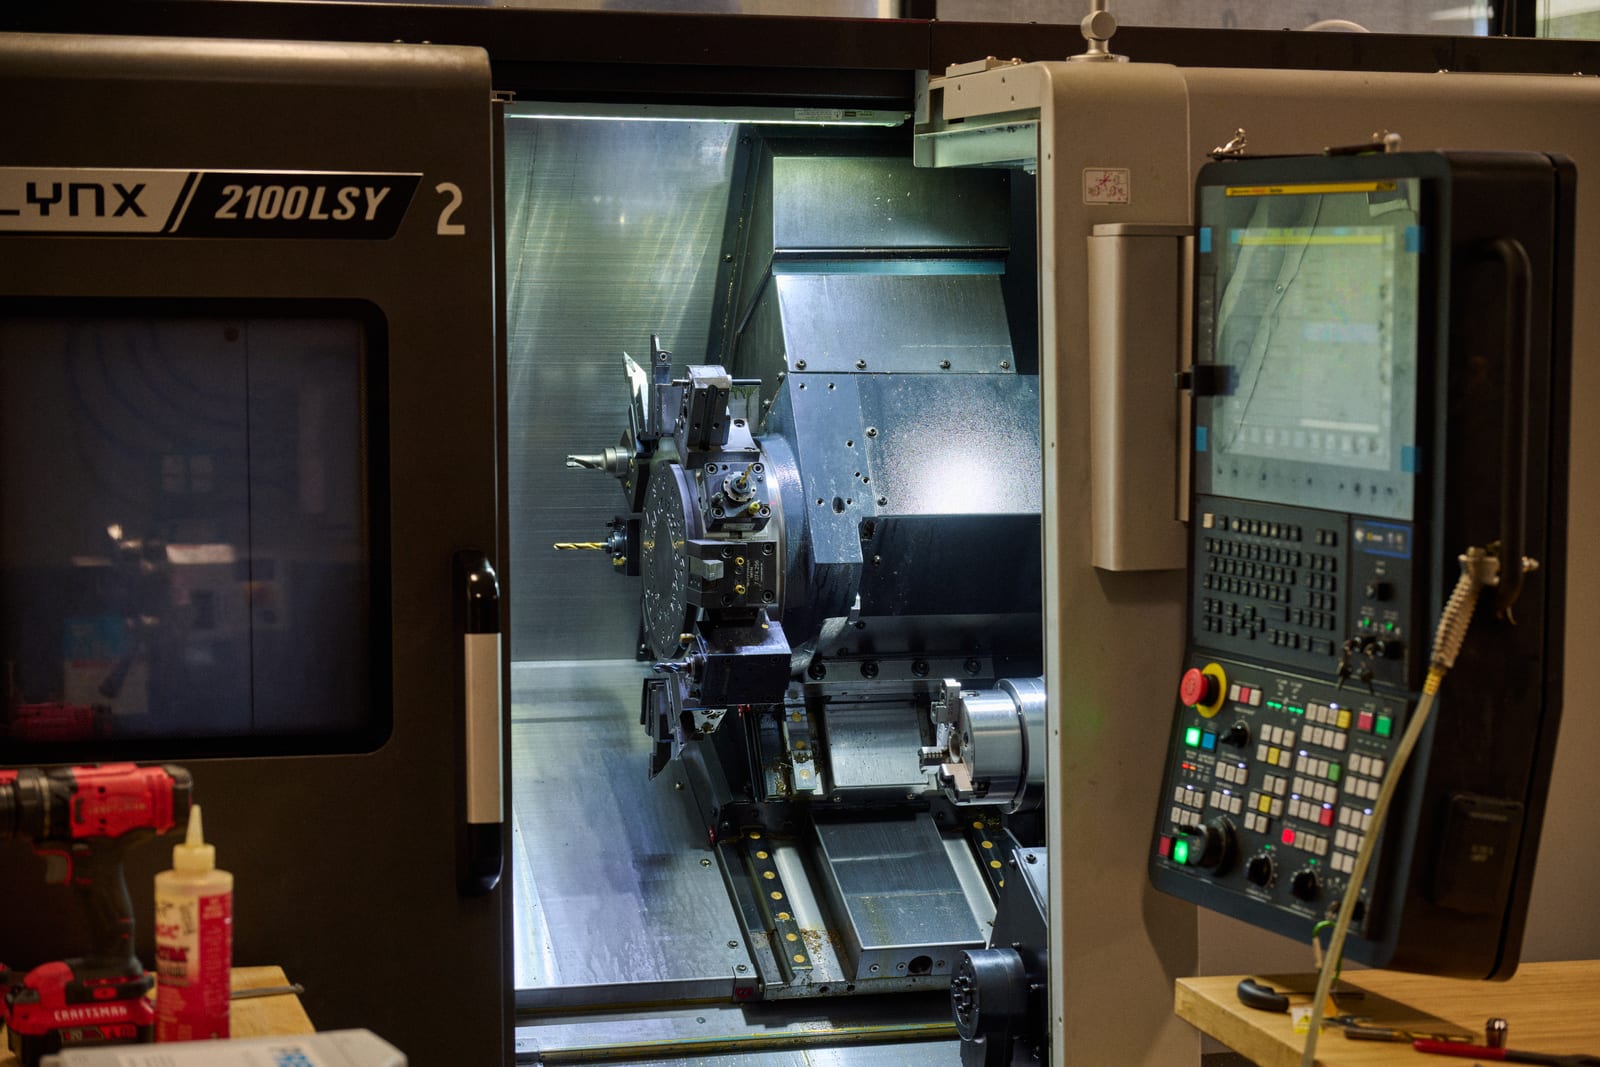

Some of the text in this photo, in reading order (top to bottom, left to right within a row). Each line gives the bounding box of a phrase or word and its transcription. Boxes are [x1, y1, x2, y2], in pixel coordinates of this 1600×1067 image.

[214, 185, 391, 221] 2100LSY
[435, 182, 466, 236] 2
[53, 1005, 128, 1022] CRAFTSMAN
